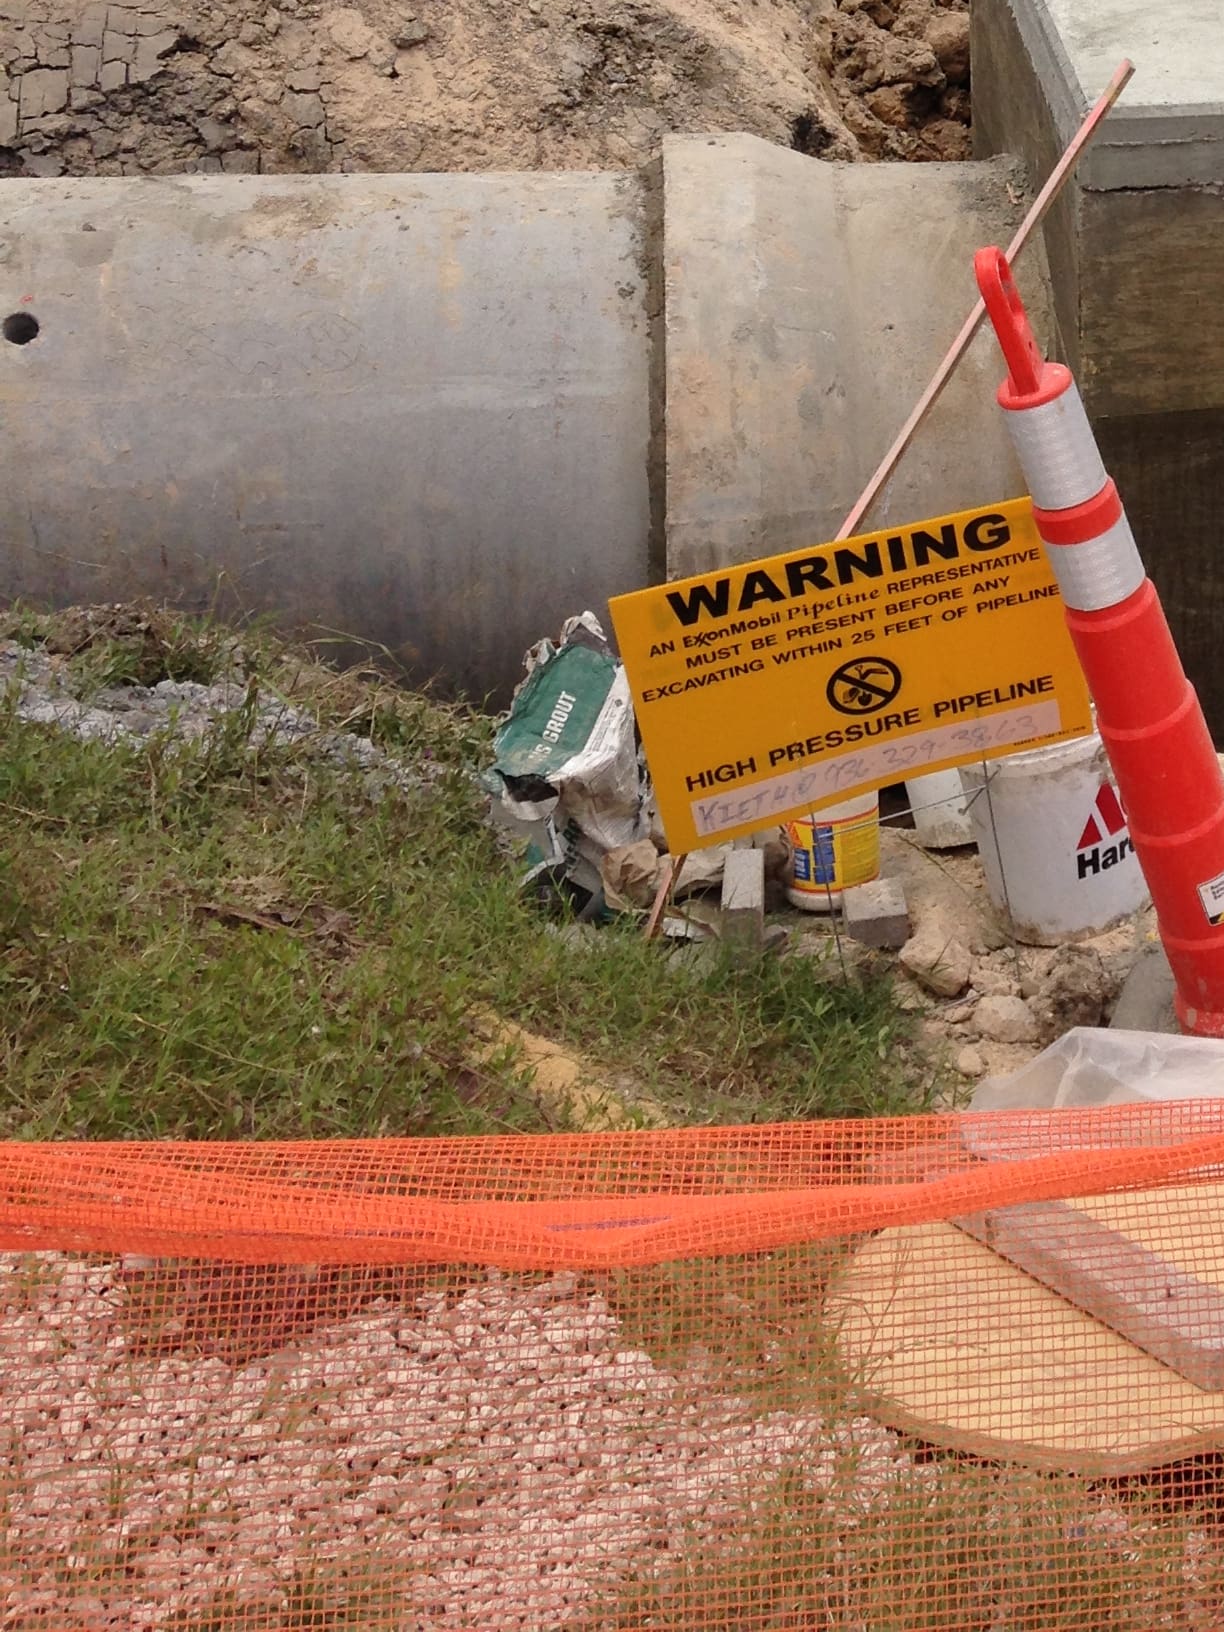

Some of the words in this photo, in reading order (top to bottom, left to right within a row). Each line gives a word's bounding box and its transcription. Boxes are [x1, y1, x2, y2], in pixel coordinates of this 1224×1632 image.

[650, 640, 675, 658] AN
[683, 611, 781, 648] ExxonMobil
[787, 589, 880, 620] Pipeline
[887, 547, 1041, 595] REPRESENTATIVE
[666, 513, 1011, 627] WARNING
[686, 643, 743, 670] MUST
[751, 633, 778, 651] BE
[786, 608, 876, 642] PRESENT
[885, 587, 964, 616] BEFORE
[972, 575, 1010, 595] ANY
[642, 659, 765, 703] EXCAVATING
[772, 637, 843, 666] WITHIN
[851, 629, 876, 645] 25
[884, 615, 933, 637] FEET
[941, 605, 968, 623] OF
[976, 583, 1061, 614] PIPELINE
[542, 690, 576, 745] GROUT
[685, 757, 757, 793] HIGH
[768, 707, 922, 767] PRESSURE
[933, 676, 1056, 718] PIPELINE
